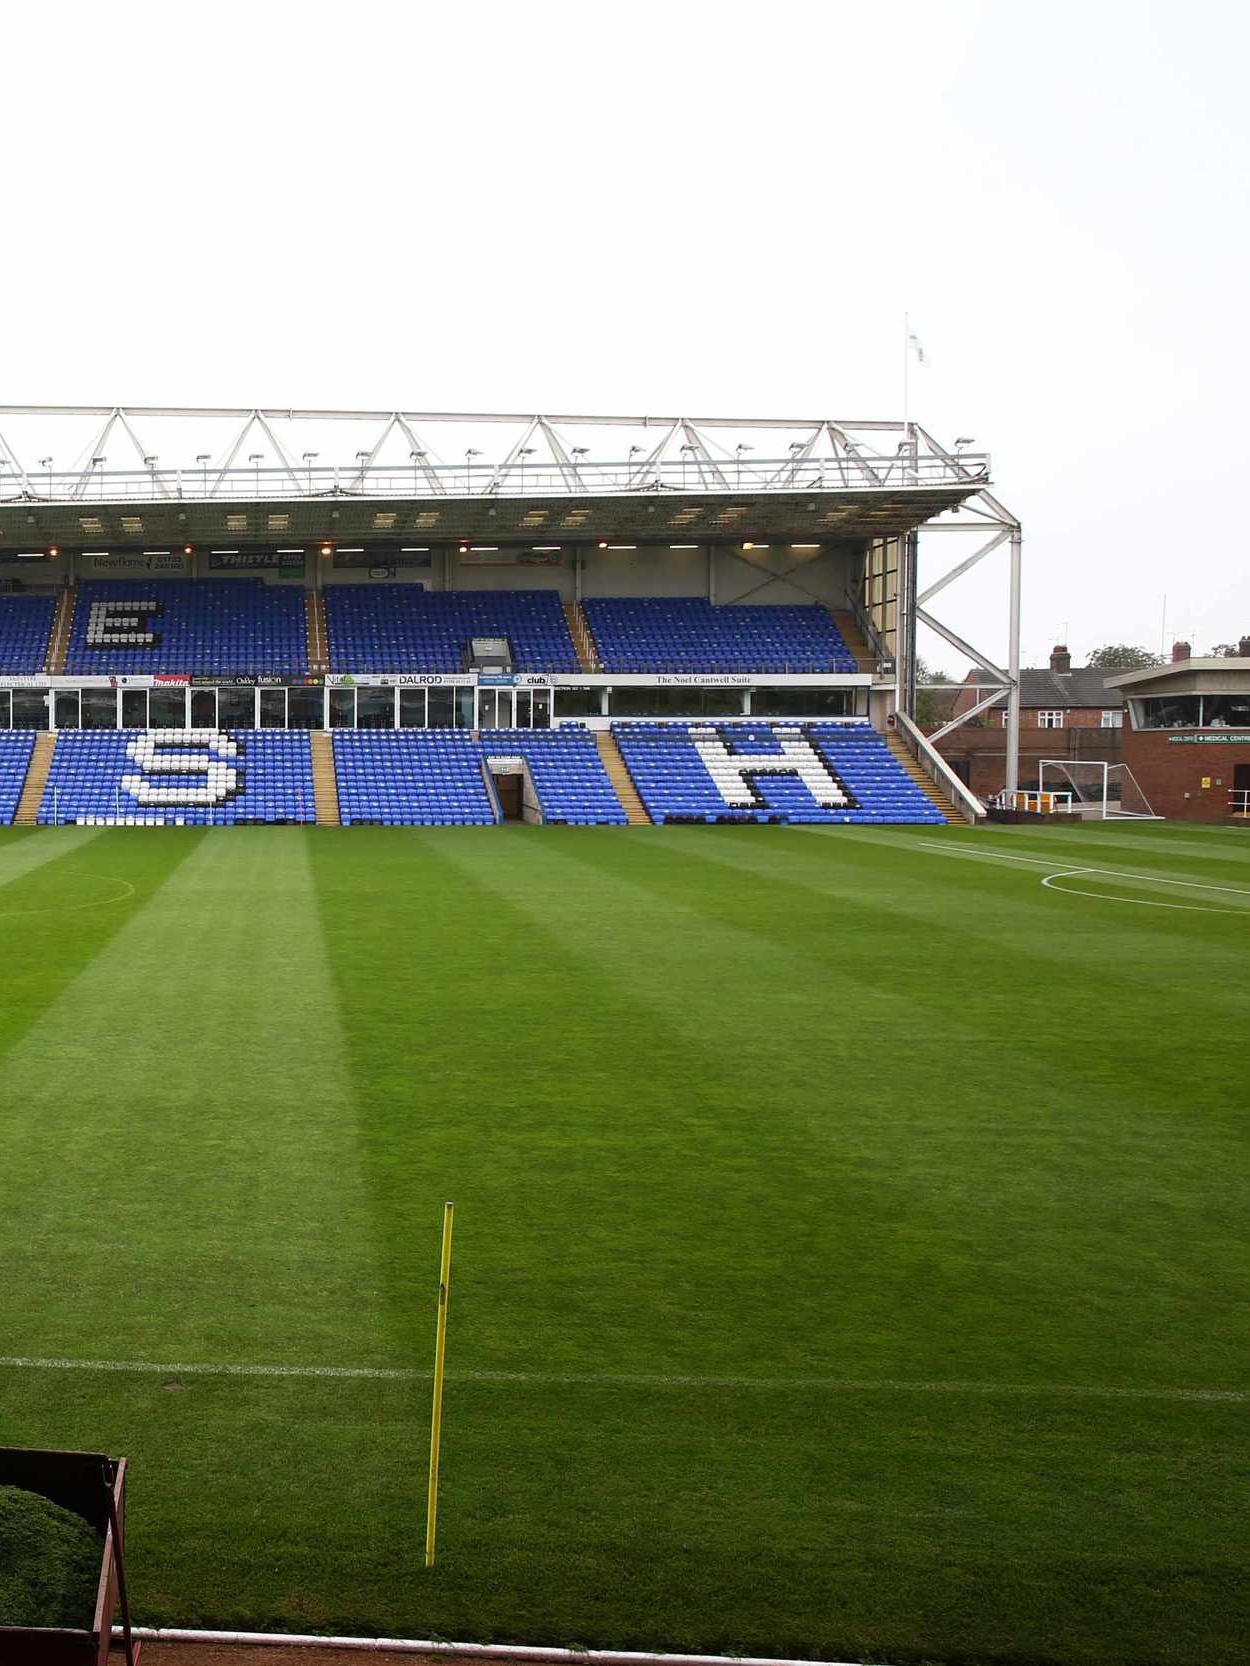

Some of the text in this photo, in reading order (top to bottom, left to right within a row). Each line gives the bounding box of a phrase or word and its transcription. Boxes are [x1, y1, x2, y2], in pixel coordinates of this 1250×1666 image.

[153, 678, 190, 687] makita
[257, 675, 282, 684] fusion
[399, 676, 443, 685] DALROD
[526, 675, 546, 684] club
[656, 676, 751, 684] The Noel Cantwell Suite
